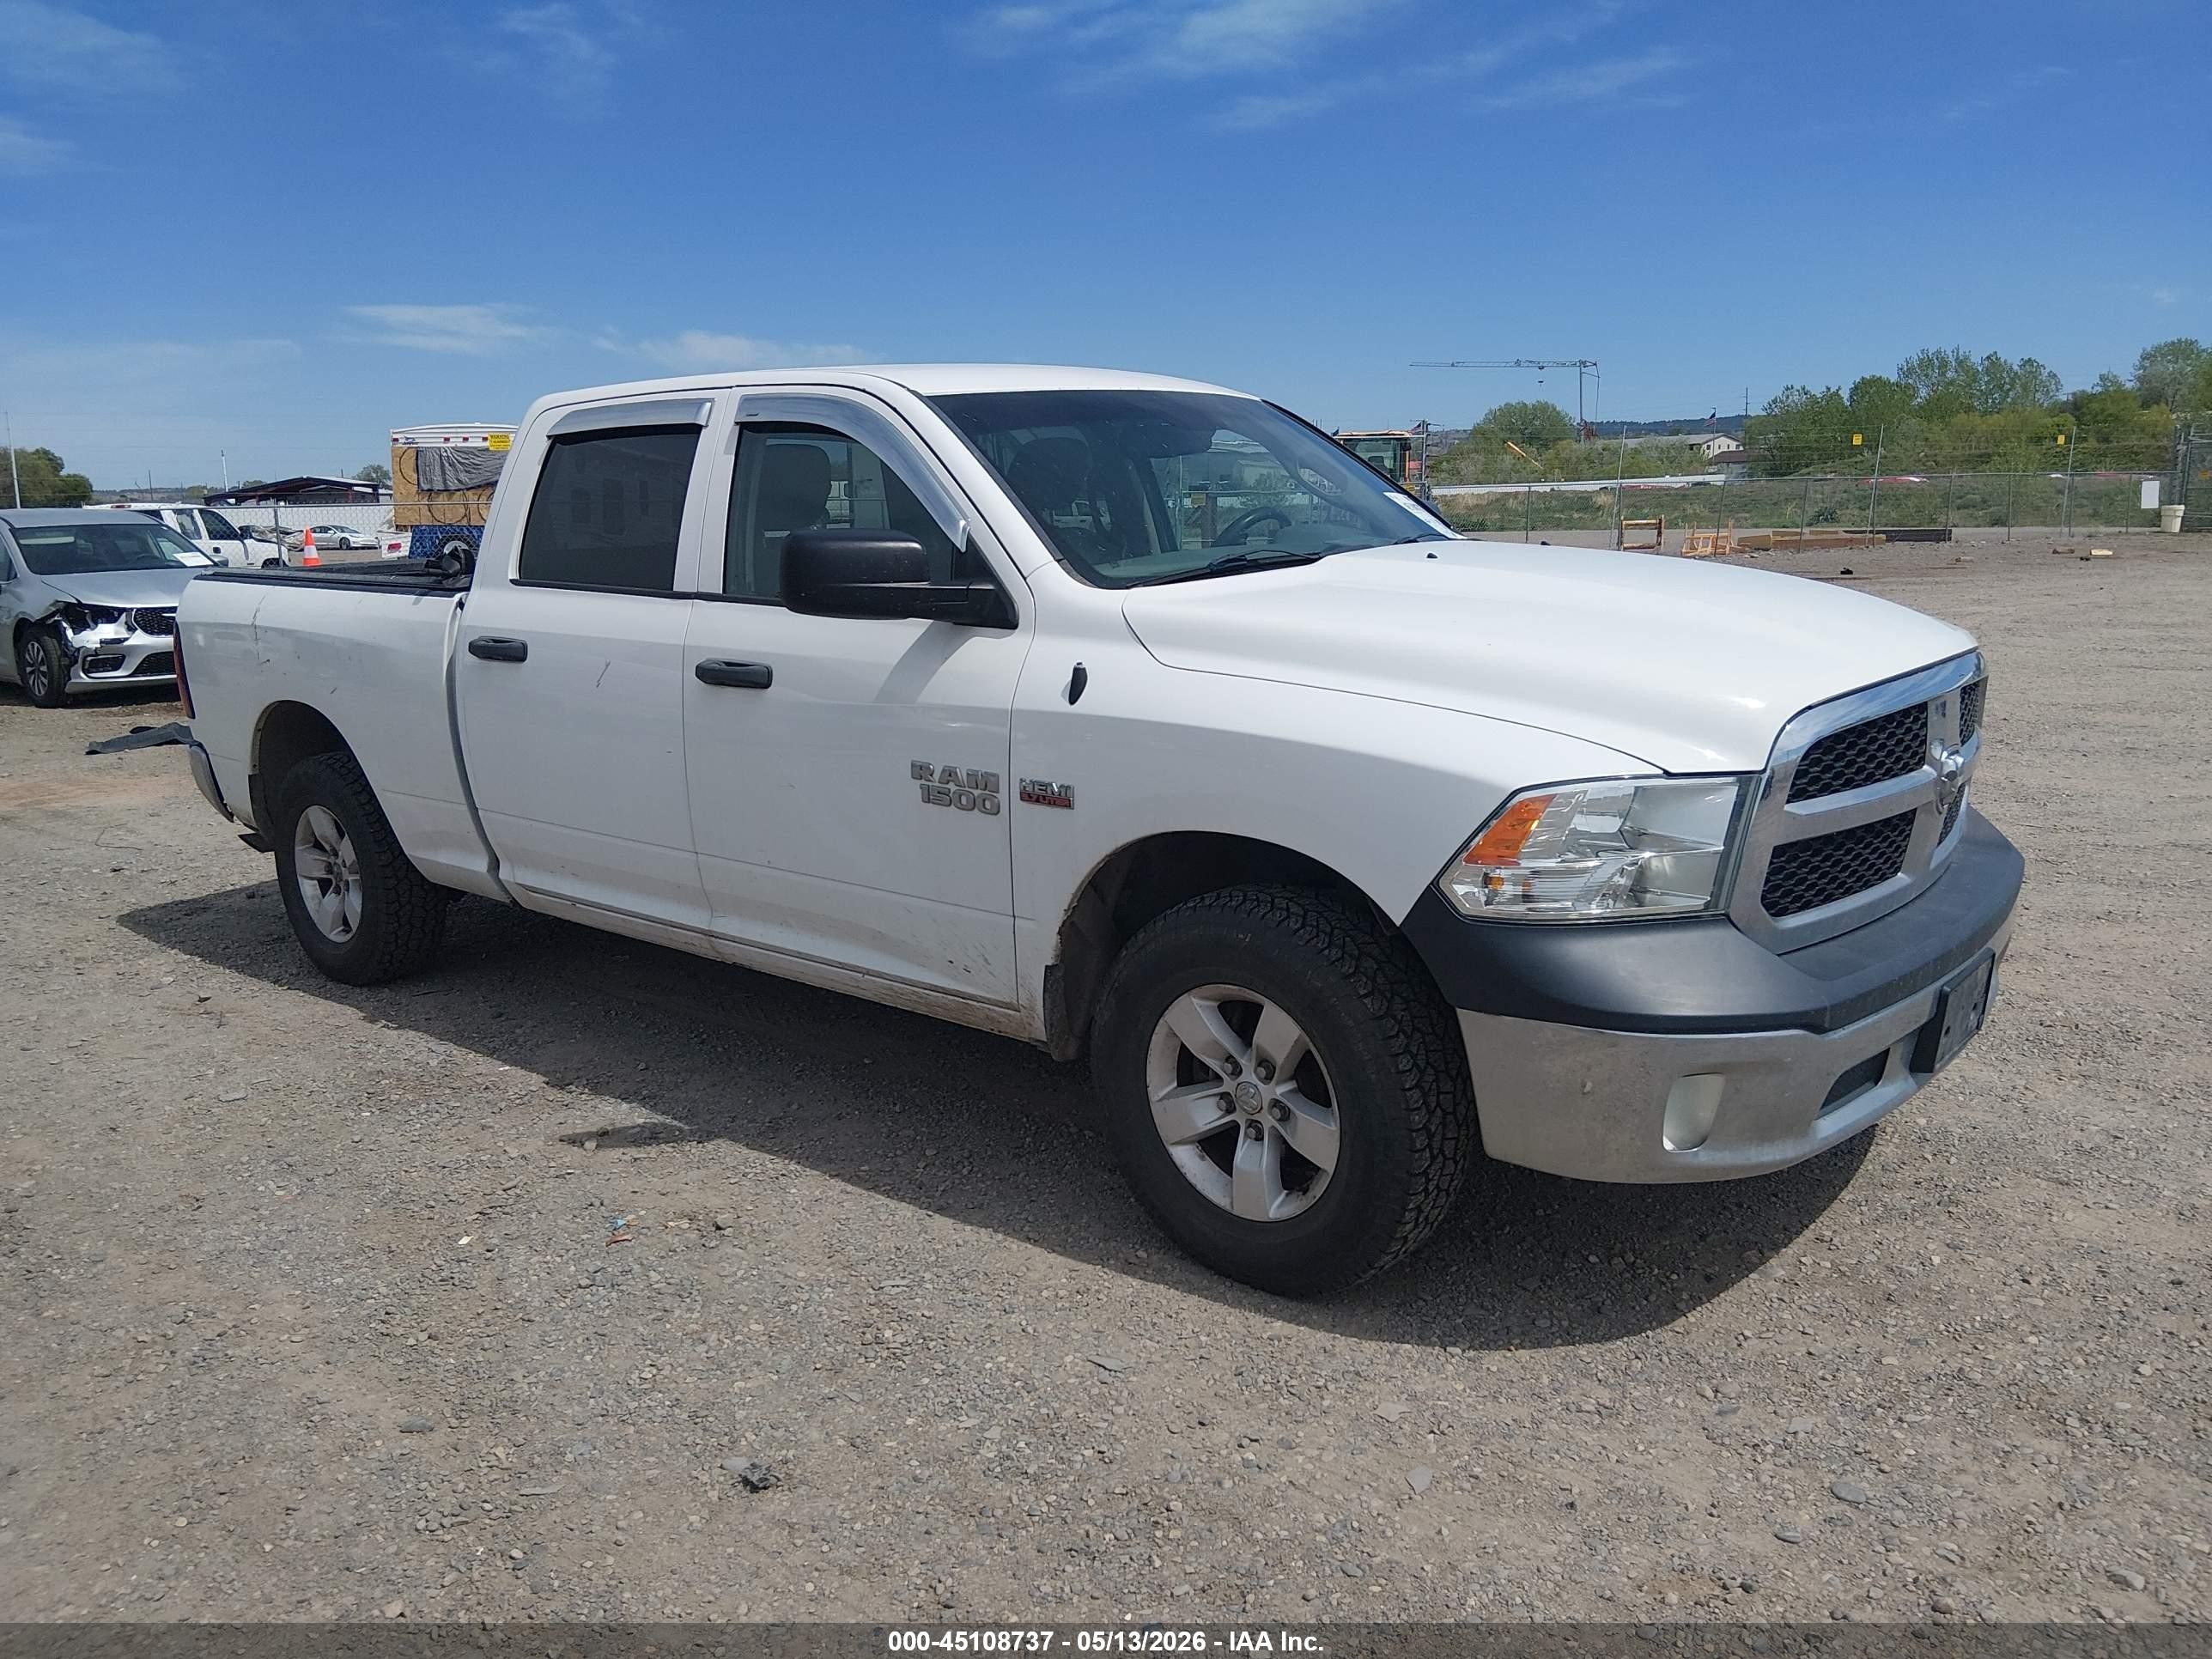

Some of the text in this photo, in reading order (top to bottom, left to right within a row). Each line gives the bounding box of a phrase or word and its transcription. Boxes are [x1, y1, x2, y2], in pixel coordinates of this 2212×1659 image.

[911, 760, 1000, 793] RAM
[1019, 778, 1074, 798] HEMI
[920, 783, 1000, 816] 1500
